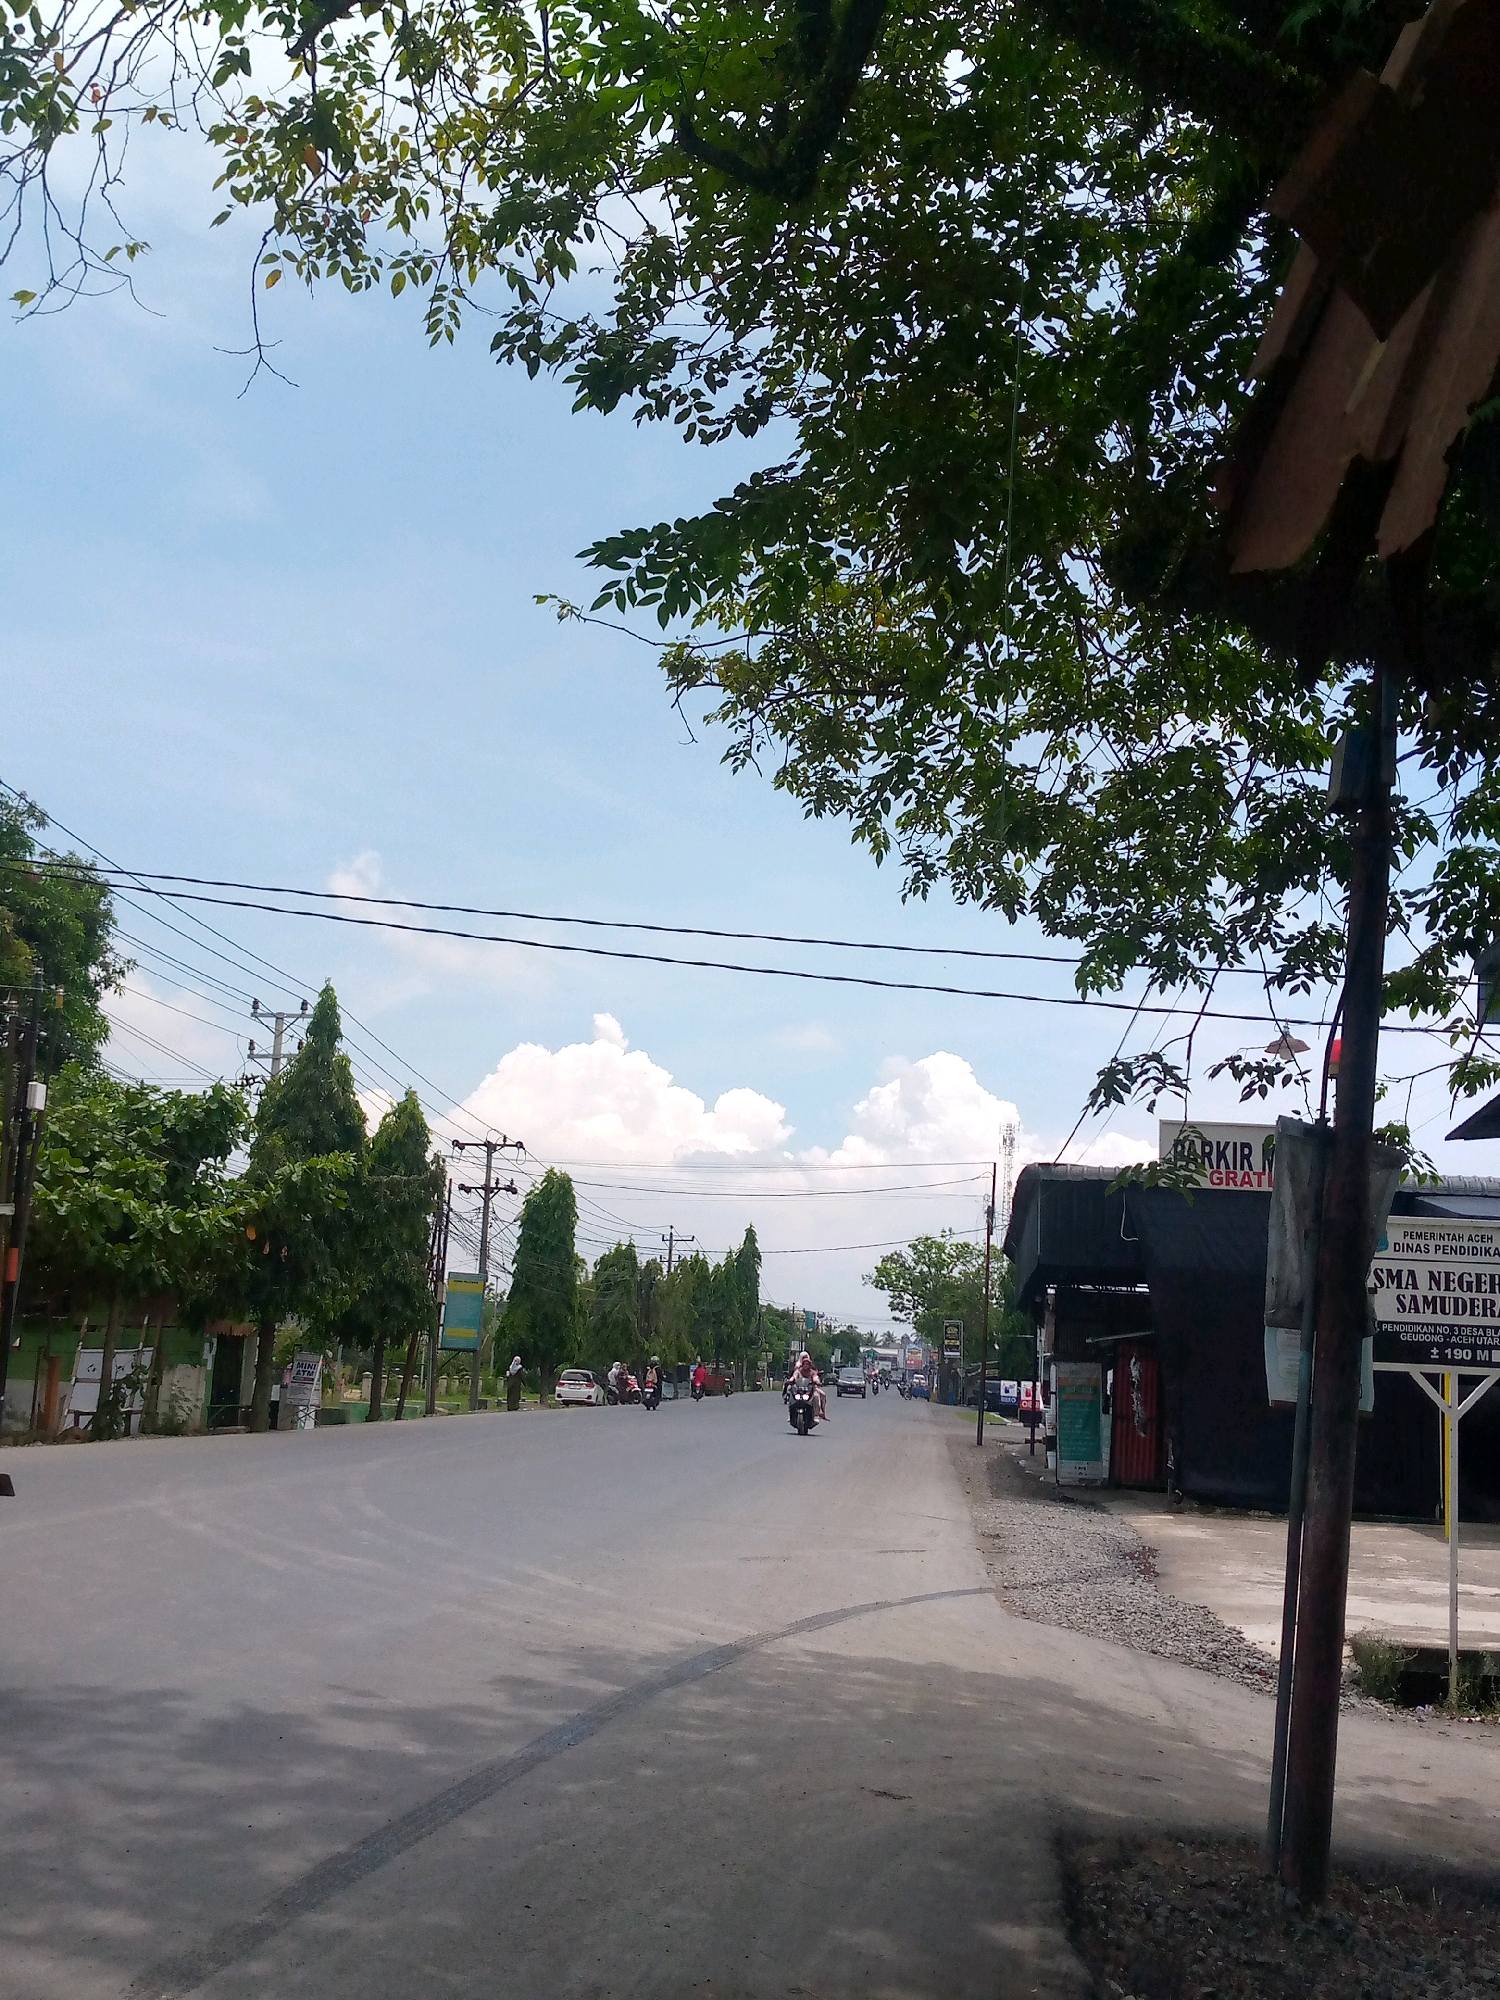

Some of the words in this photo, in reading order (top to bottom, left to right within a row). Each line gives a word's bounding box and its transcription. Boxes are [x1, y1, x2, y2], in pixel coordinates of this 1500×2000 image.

[1403, 1231, 1464, 1243] PEMERINTAH
[1467, 1234, 1493, 1244] ACEH
[1393, 1242, 1430, 1254] DINAS
[1434, 1244, 1500, 1257] PENDIDIKA
[1373, 1268, 1419, 1289] SMA
[1396, 1294, 1500, 1318] SAMUDER
[1382, 1323, 1434, 1334] PENDIDIKAN
[1453, 1326, 1459, 1336] 3
[1460, 1327, 1484, 1337] DESA
[1400, 1333, 1444, 1343] GEUDONG
[1444, 1348, 1472, 1360] 190
[1476, 1350, 1489, 1361] M
[296, 1362, 317, 1370] MINI
